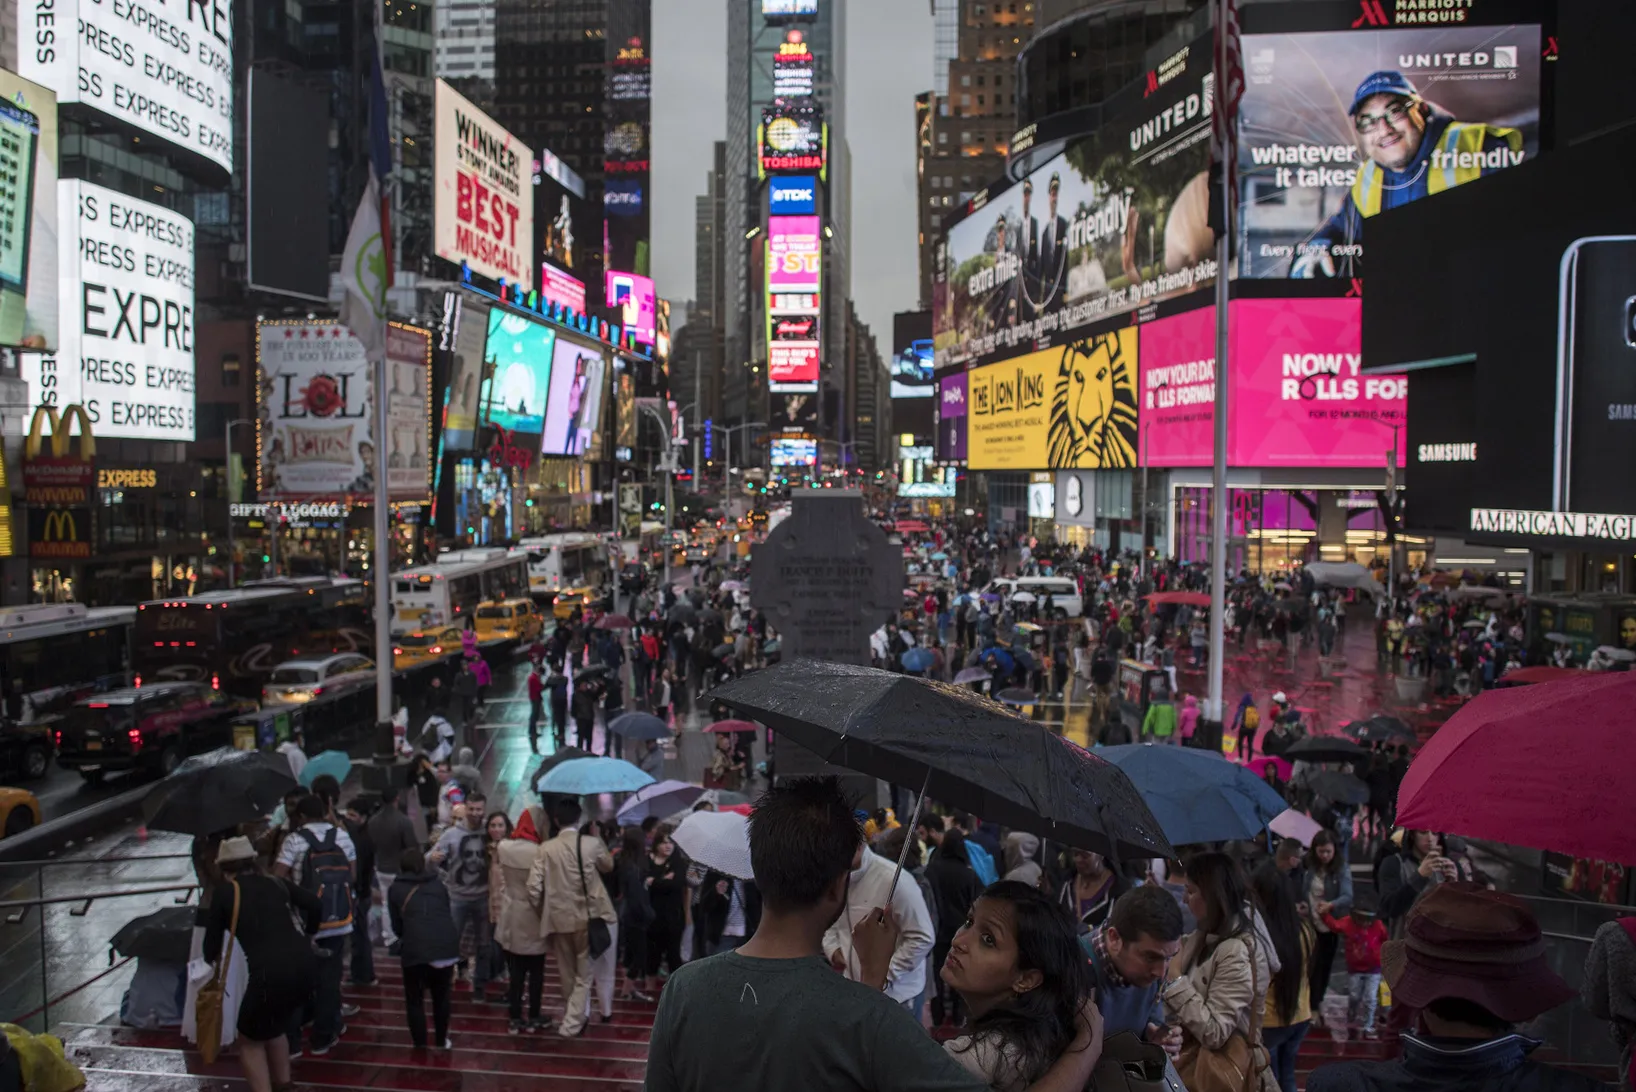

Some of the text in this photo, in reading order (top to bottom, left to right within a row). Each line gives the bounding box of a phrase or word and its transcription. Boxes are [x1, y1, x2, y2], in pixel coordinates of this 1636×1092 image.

[1396, 9, 1465, 23] MARQUIS
[1399, 52, 1490, 69] UNITED
[144, 53, 215, 109] EXPRESS
[114, 83, 191, 138] EXPRESS
[1130, 94, 1200, 151] UNITED
[455, 108, 520, 180] WINNER!
[1251, 144, 1357, 165] whatever
[763, 156, 822, 169] TOSHIBA
[1430, 147, 1525, 169] friendly
[1276, 166, 1357, 187] it takes
[783, 189, 813, 201] TDK
[456, 170, 519, 248] BEST
[1068, 192, 1131, 250] friendly
[110, 203, 184, 250] EXPRESS
[456, 224, 521, 278] MUSICAL!
[1260, 243, 1294, 257] Every
[968, 250, 1018, 297] extra mile
[1142, 279, 1157, 298] the
[1158, 266, 1195, 295] friendly
[1195, 258, 1218, 282] skie
[1147, 366, 1169, 389] NOW
[1170, 361, 1198, 385] YOUR
[1282, 353, 1342, 376] NOW
[973, 385, 988, 409] THE
[990, 374, 1014, 416] LION
[1016, 367, 1044, 411] KING
[1282, 378, 1359, 400] ROLLS
[112, 402, 184, 428] EXPRESS
[97, 469, 157, 487] EXPRESS
[1474, 510, 1577, 537] AMERICAN
